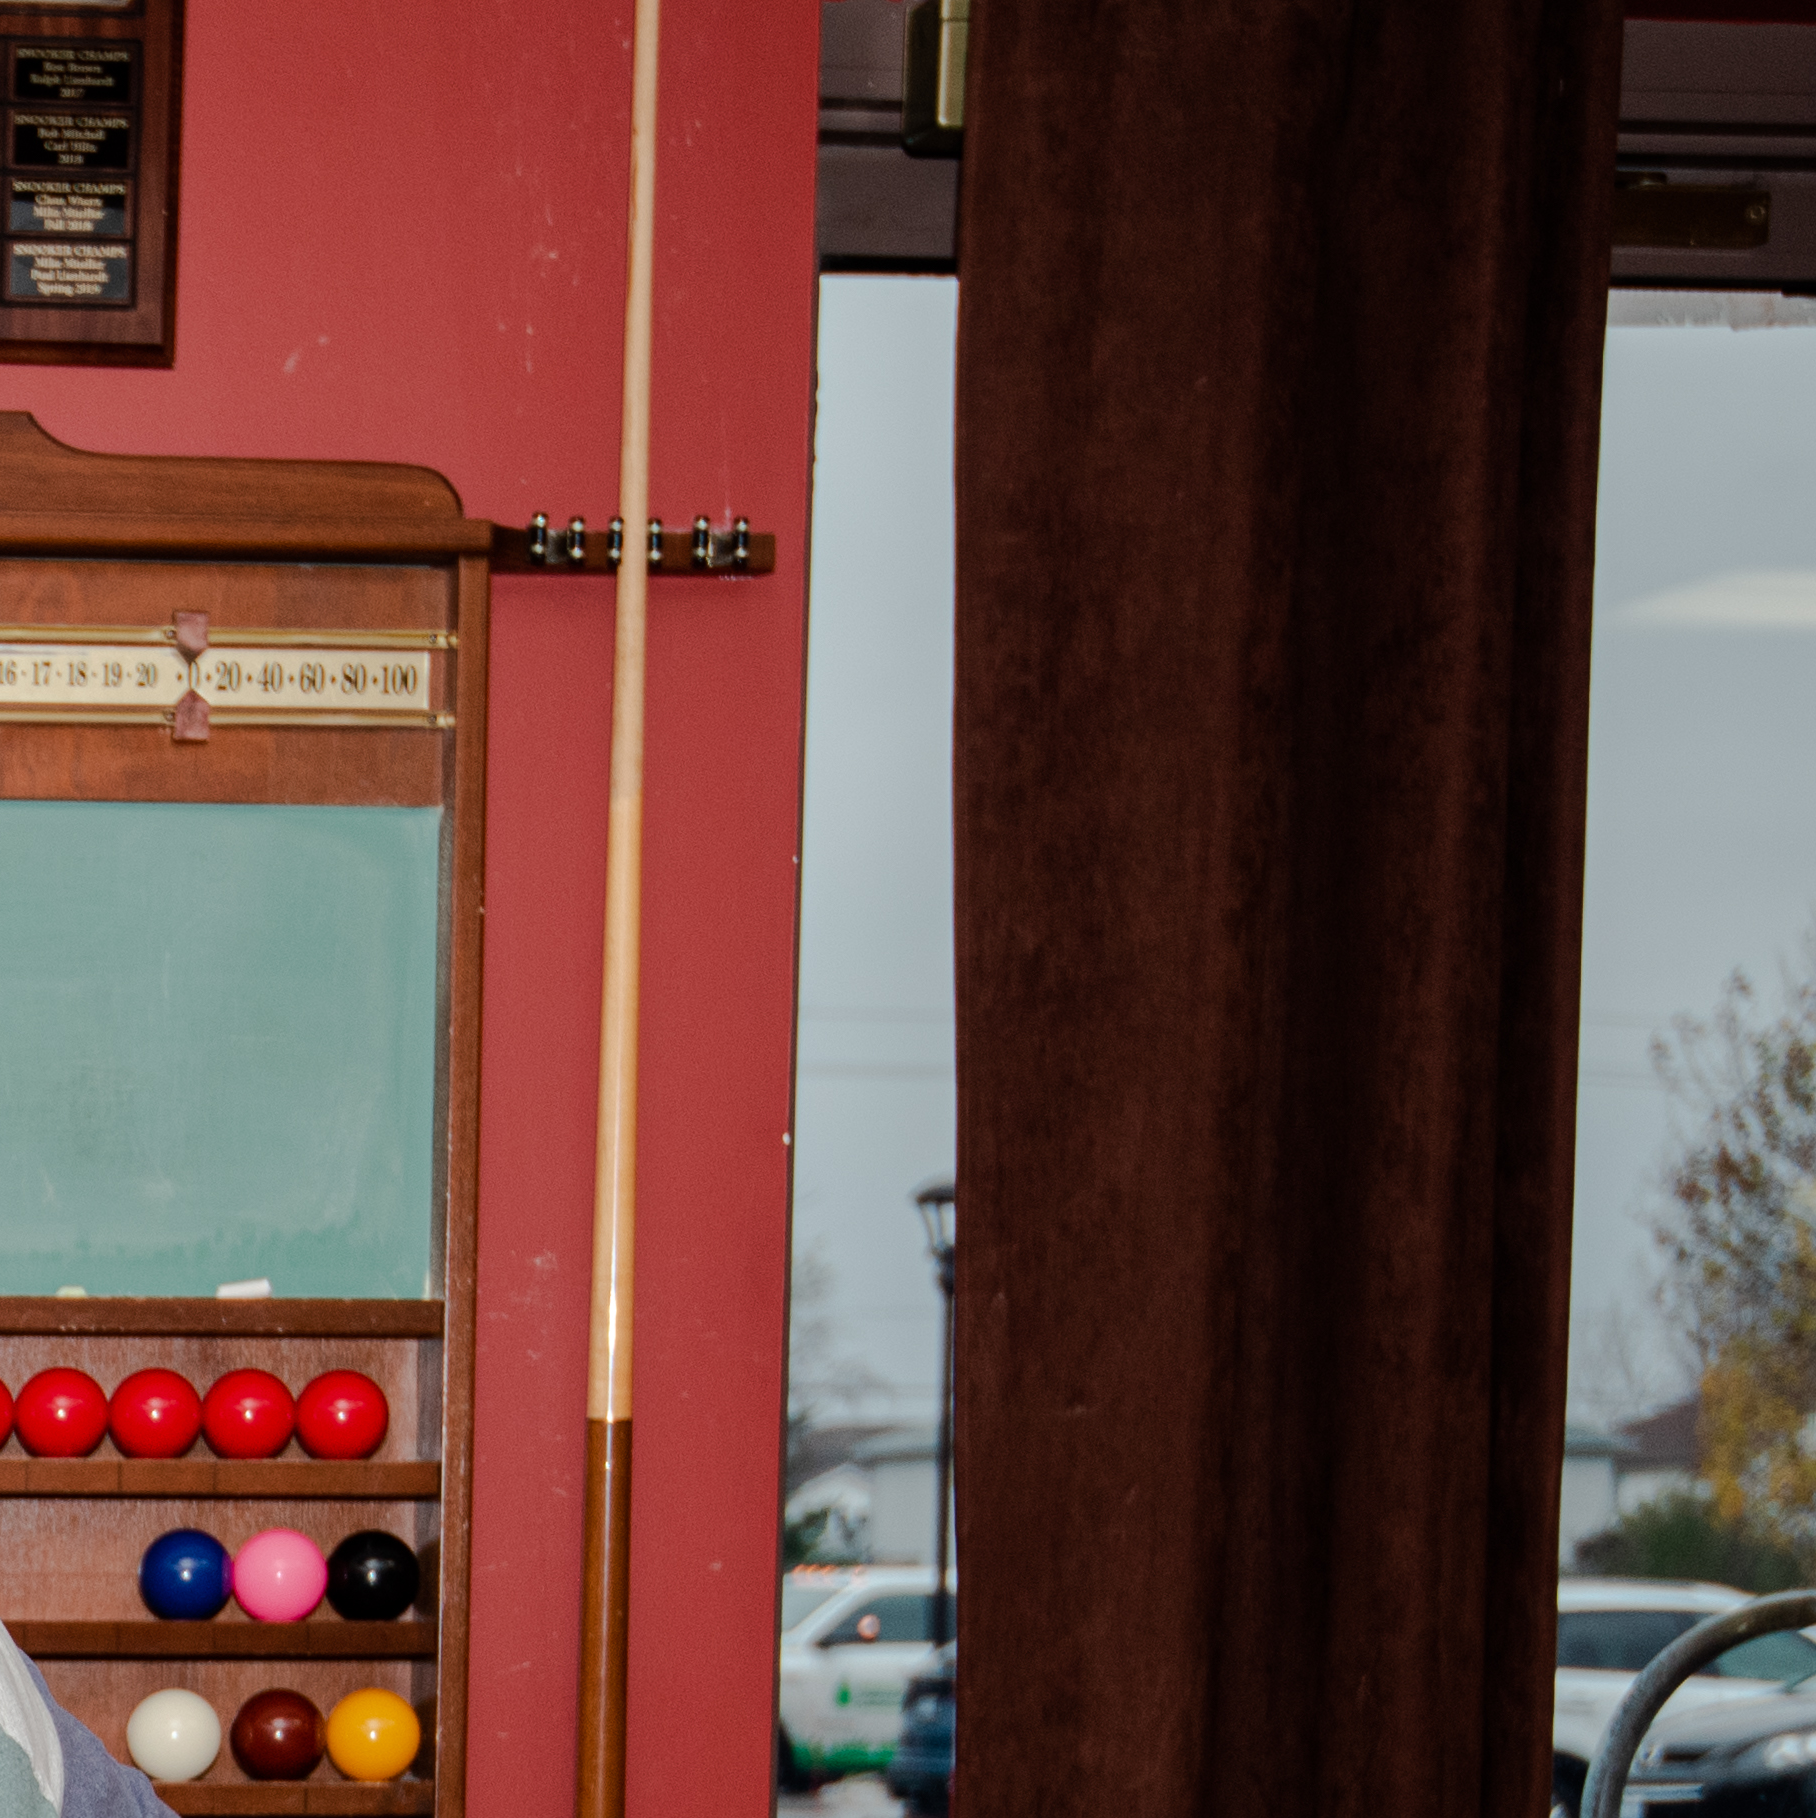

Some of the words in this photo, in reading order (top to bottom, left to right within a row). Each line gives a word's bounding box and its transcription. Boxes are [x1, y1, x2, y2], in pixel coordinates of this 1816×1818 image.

[12, 181, 71, 193] SNOOKER
[73, 182, 126, 195] CHAMPS
[13, 244, 72, 256] SNOOKER
[74, 245, 127, 258] CHAMPS
[33, 660, 52, 687] 17
[68, 661, 87, 687] 18
[103, 661, 123, 688] 19
[136, 662, 158, 689] 20
[188, 661, 200, 691] 0
[215, 662, 241, 693] 20
[256, 662, 283, 694] 40
[299, 663, 325, 695] 60
[341, 664, 367, 695] 80
[382, 664, 418, 696] 100
